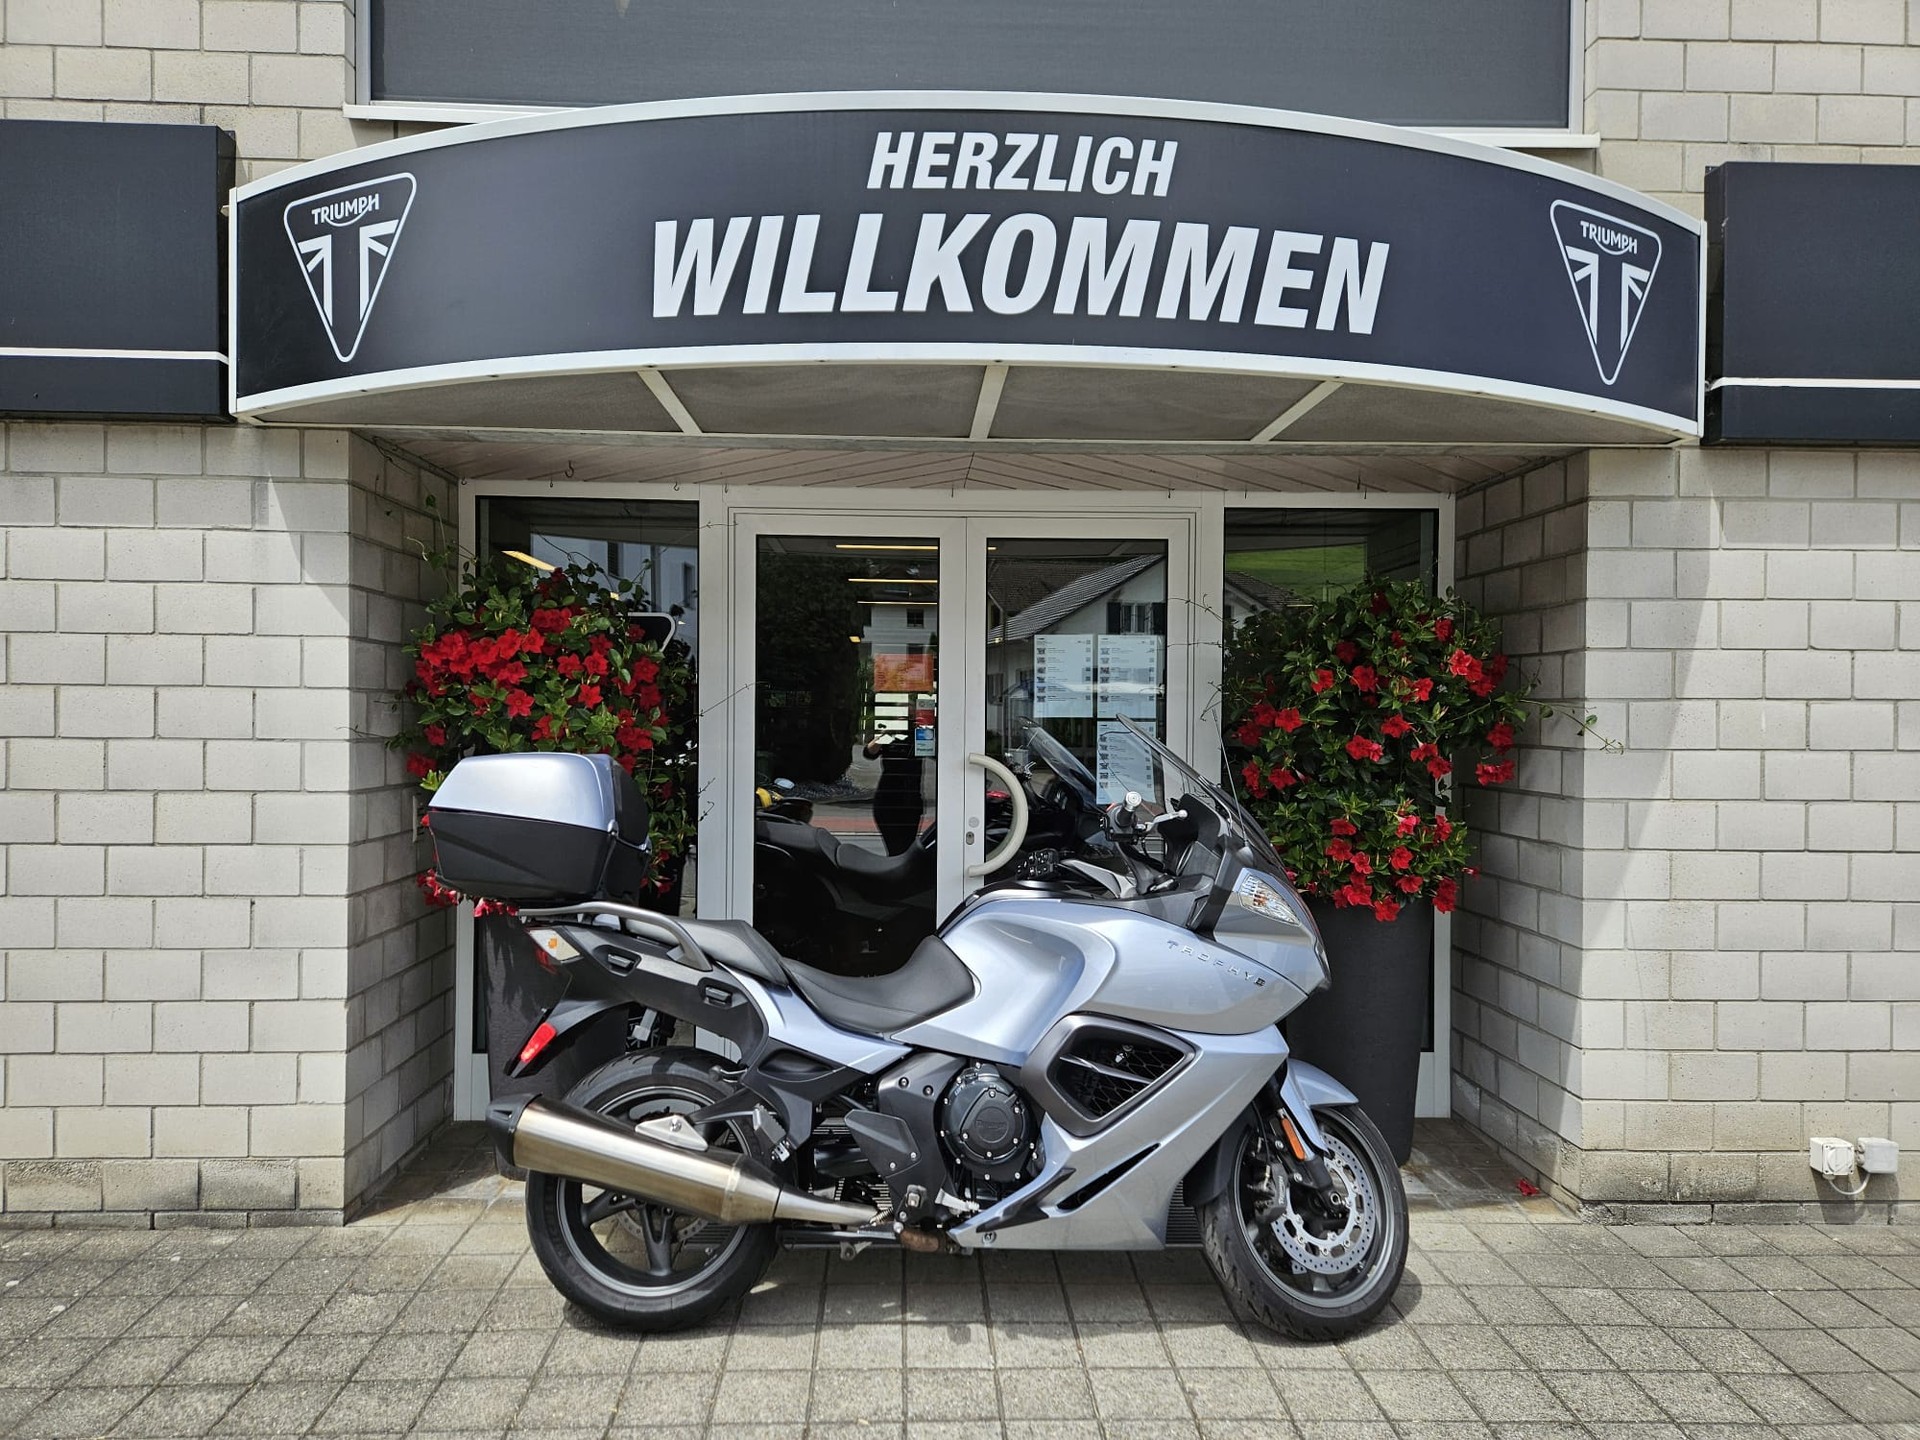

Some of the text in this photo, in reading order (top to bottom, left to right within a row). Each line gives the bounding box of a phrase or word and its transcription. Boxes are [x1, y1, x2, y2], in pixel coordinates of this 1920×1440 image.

[867, 132, 1178, 197] HERZLICH
[311, 193, 380, 227] TRIUMPH
[1580, 220, 1638, 255] TRIUMPH
[653, 213, 1390, 335] WILLKOMMEN
